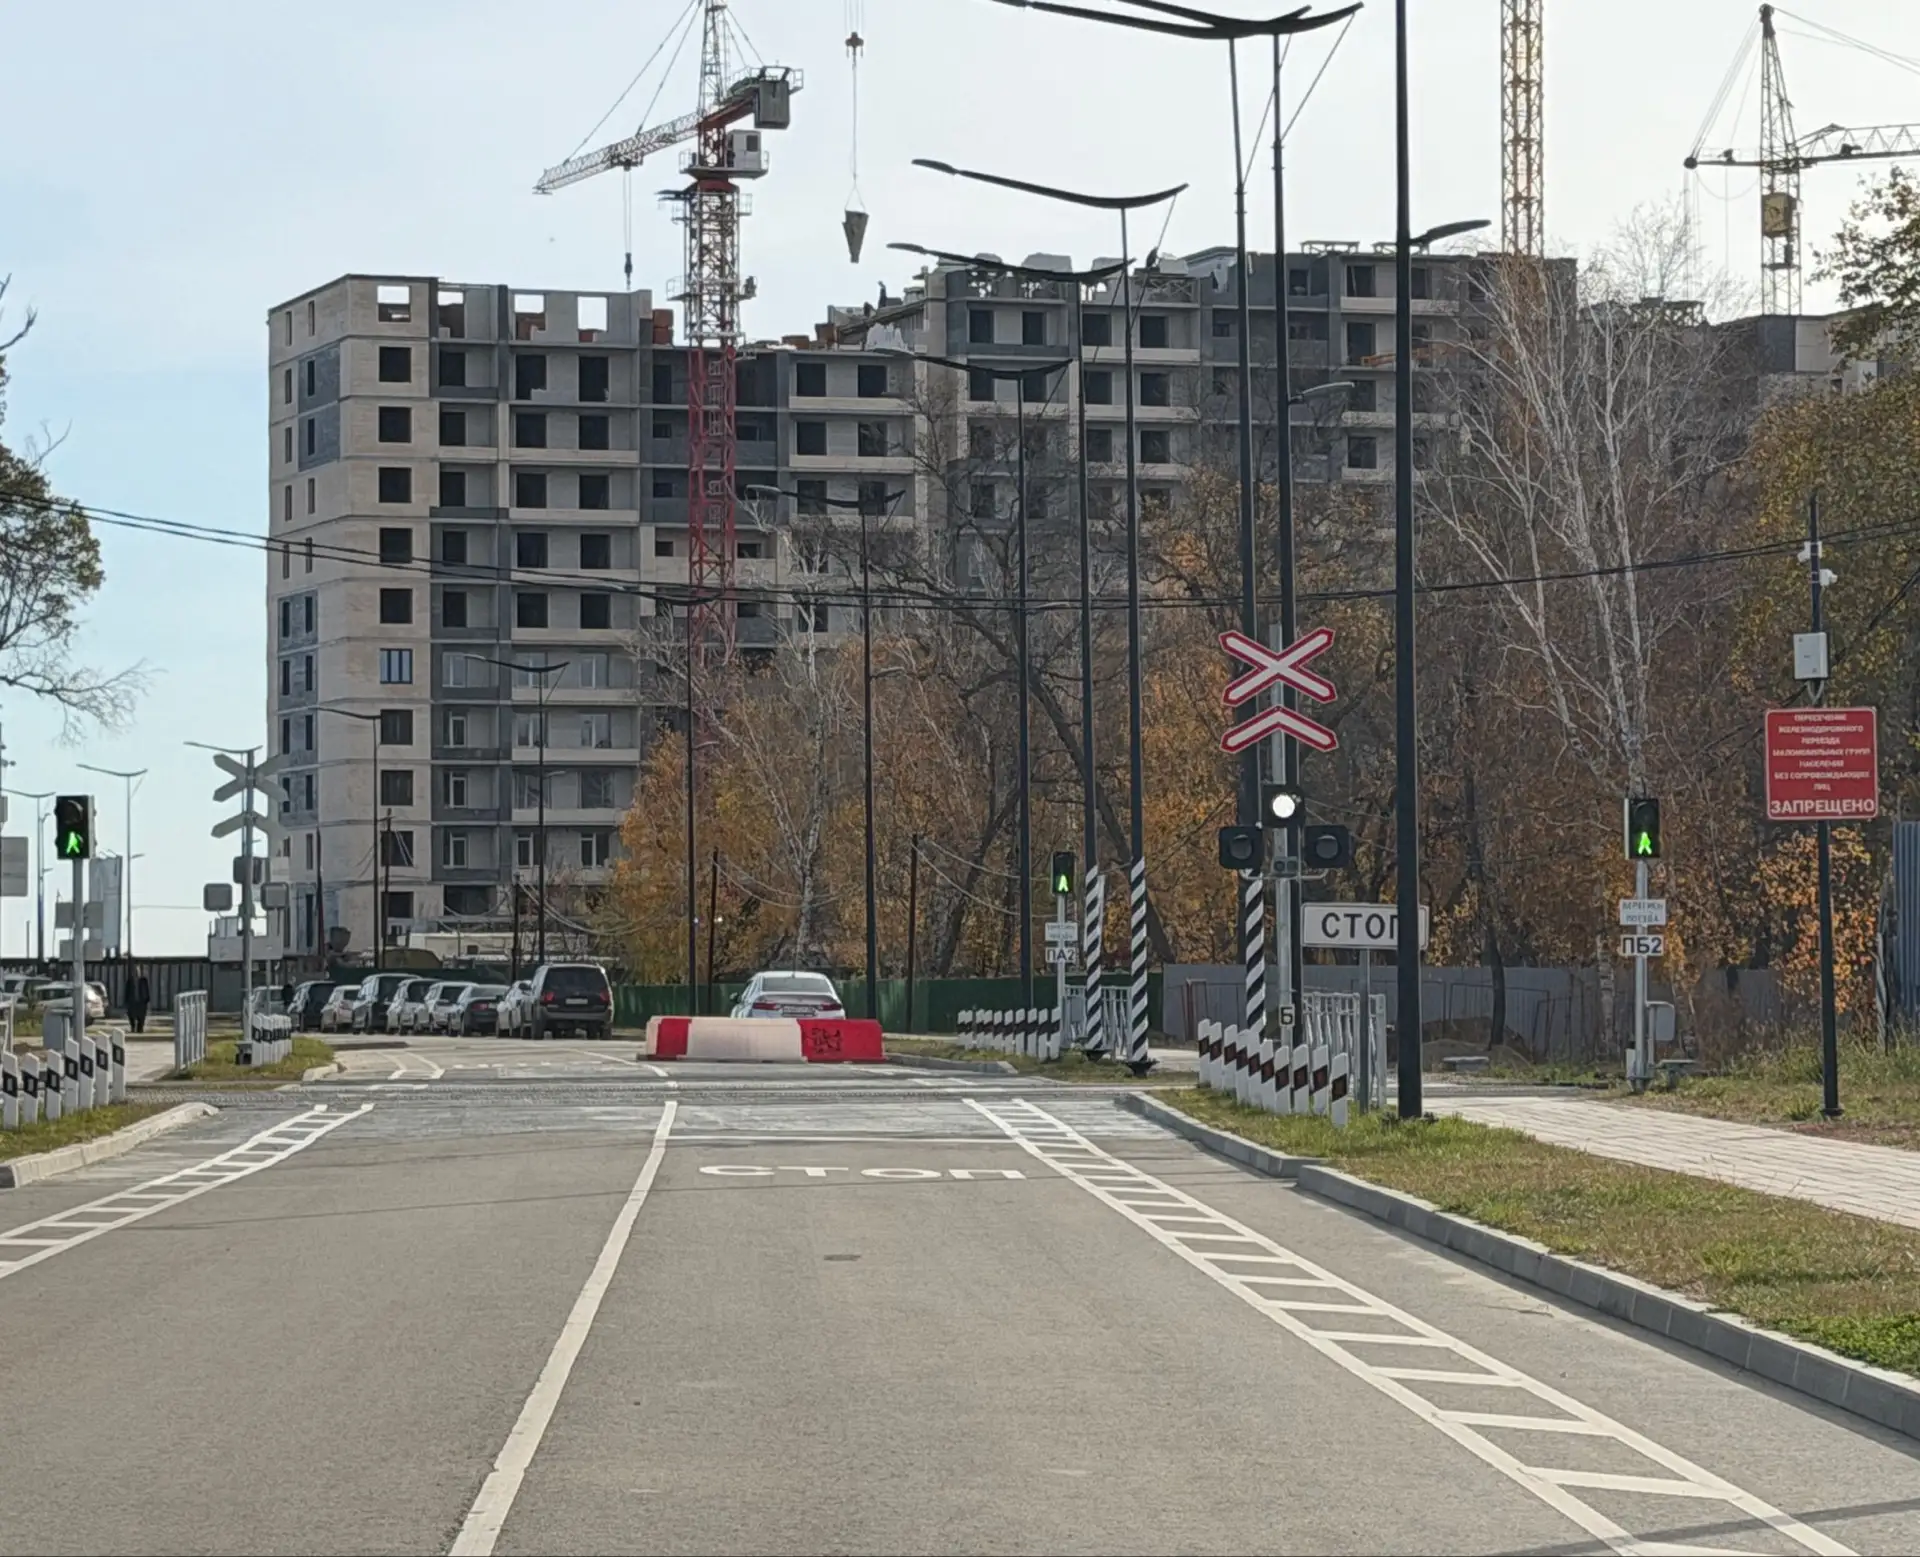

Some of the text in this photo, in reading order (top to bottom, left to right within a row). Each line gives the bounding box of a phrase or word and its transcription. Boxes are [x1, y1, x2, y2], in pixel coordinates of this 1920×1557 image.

[1770, 799, 1875, 815] ЗАПРЕЩЕНО
[1623, 936, 1662, 954] ПБ2
[699, 1165, 1027, 1180] СТОП
